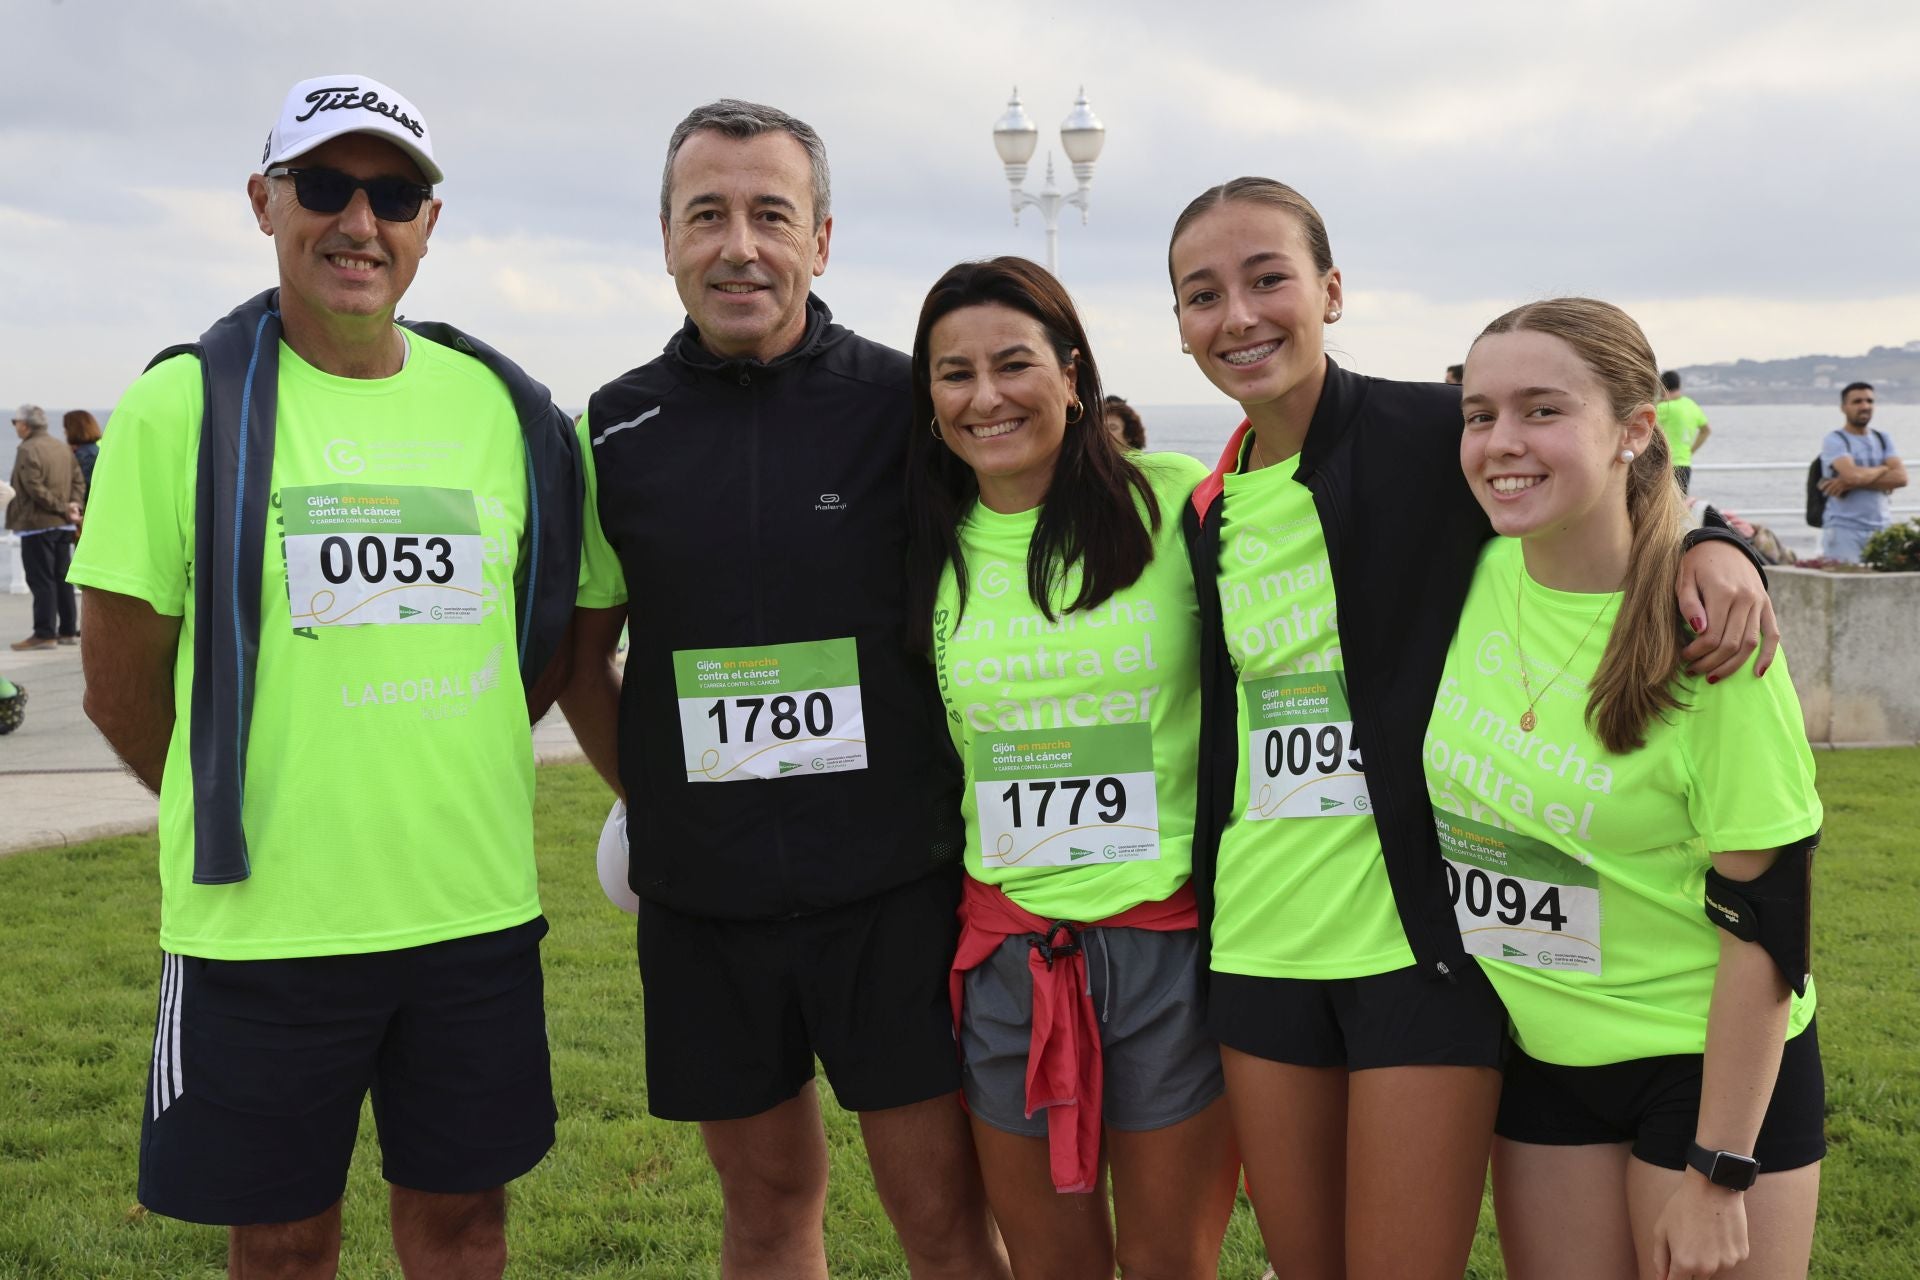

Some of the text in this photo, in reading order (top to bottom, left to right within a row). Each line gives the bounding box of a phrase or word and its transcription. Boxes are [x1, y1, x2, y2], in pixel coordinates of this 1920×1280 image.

[296, 87, 424, 138] Titleist
[307, 496, 400, 507] Gijón en marcha
[309, 506, 401, 517] contra el cáncer
[320, 536, 455, 584] 0053
[1221, 580, 1253, 615] En
[953, 615, 995, 642] En
[697, 658, 778, 671] Gijón en marcha
[953, 632, 1159, 687] contra el
[698, 669, 780, 681] contra el cáncer
[341, 676, 466, 707] LABORAL
[1262, 683, 1327, 700] Gijón en marcha
[1262, 696, 1328, 711] contra el cáncer
[708, 692, 833, 743] 1780
[966, 684, 1160, 732] cáncer
[992, 743, 1015, 755] Gijón
[1031, 740, 1072, 750] marcha
[1434, 677, 1614, 794] En marcha
[993, 751, 1072, 764] contra el cáncer
[1002, 777, 1127, 828] 1779
[1543, 801, 1595, 840] el
[1451, 826, 1463, 836] en
[1465, 832, 1505, 848] marcha
[1458, 840, 1468, 849] el
[1470, 844, 1507, 858] cáncer
